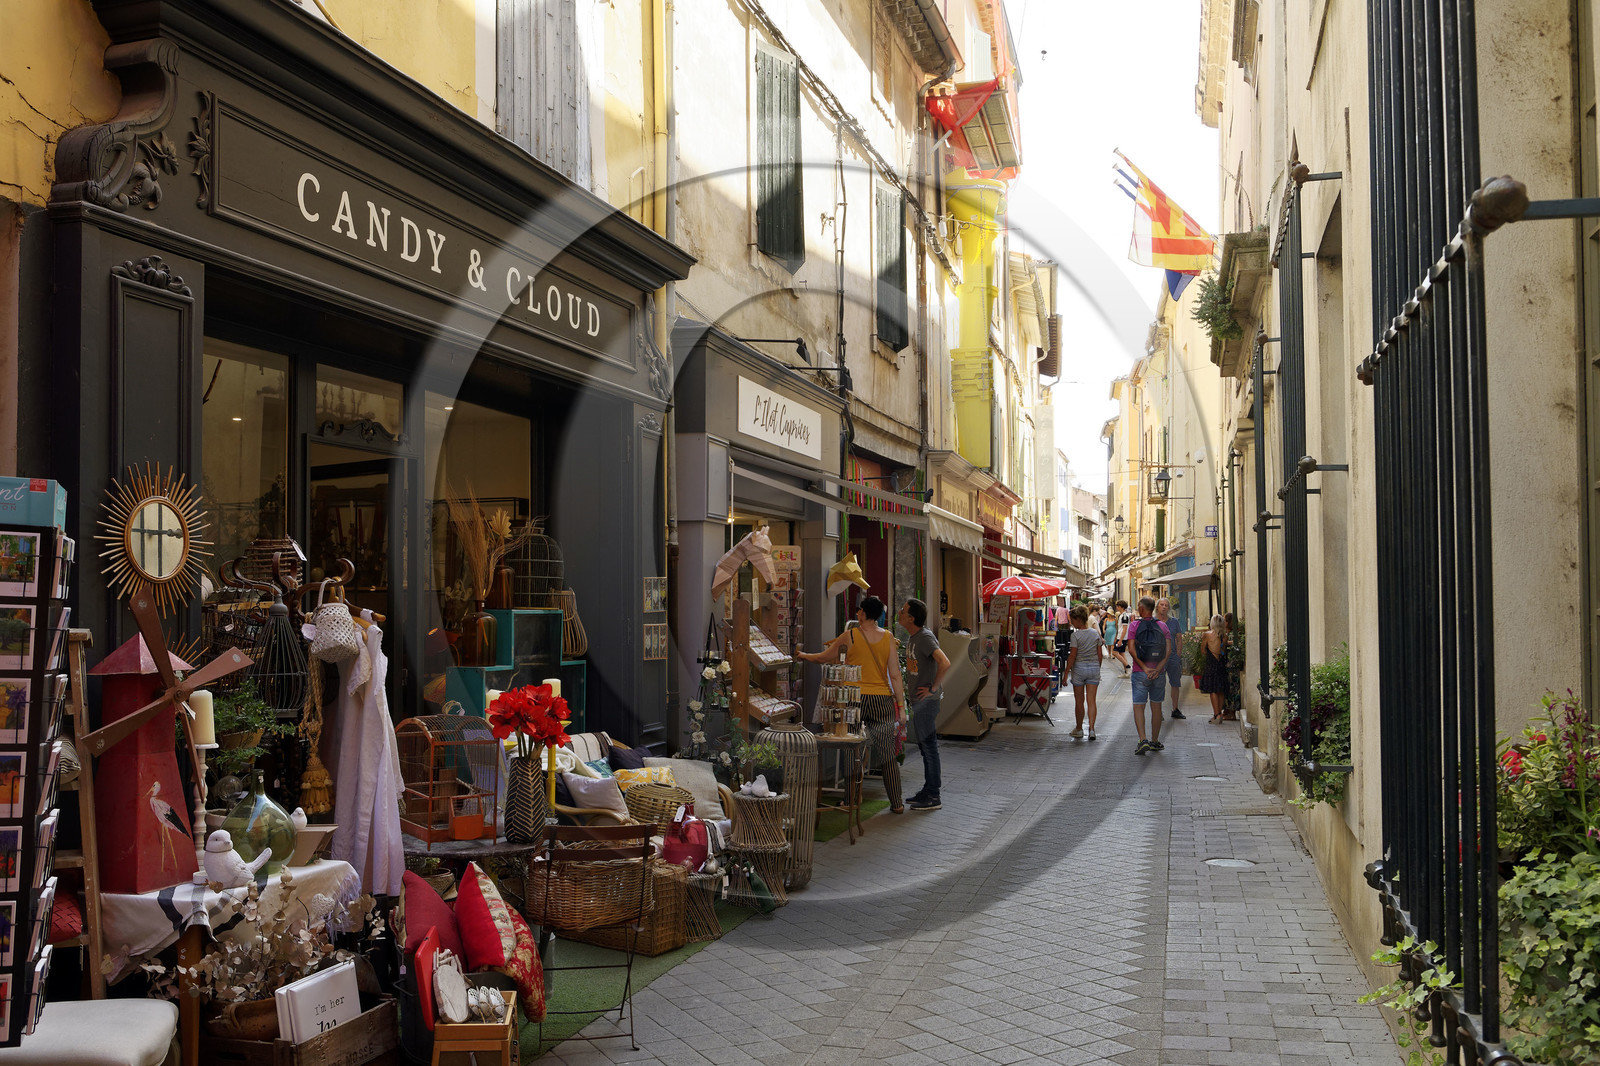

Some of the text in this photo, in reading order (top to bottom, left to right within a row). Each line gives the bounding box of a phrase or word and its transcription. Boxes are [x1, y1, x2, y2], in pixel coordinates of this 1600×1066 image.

[297, 172, 600, 337] CANDY & CLOUD
[779, 404, 811, 447] Caprices
[314, 996, 345, 1016] I'm her
